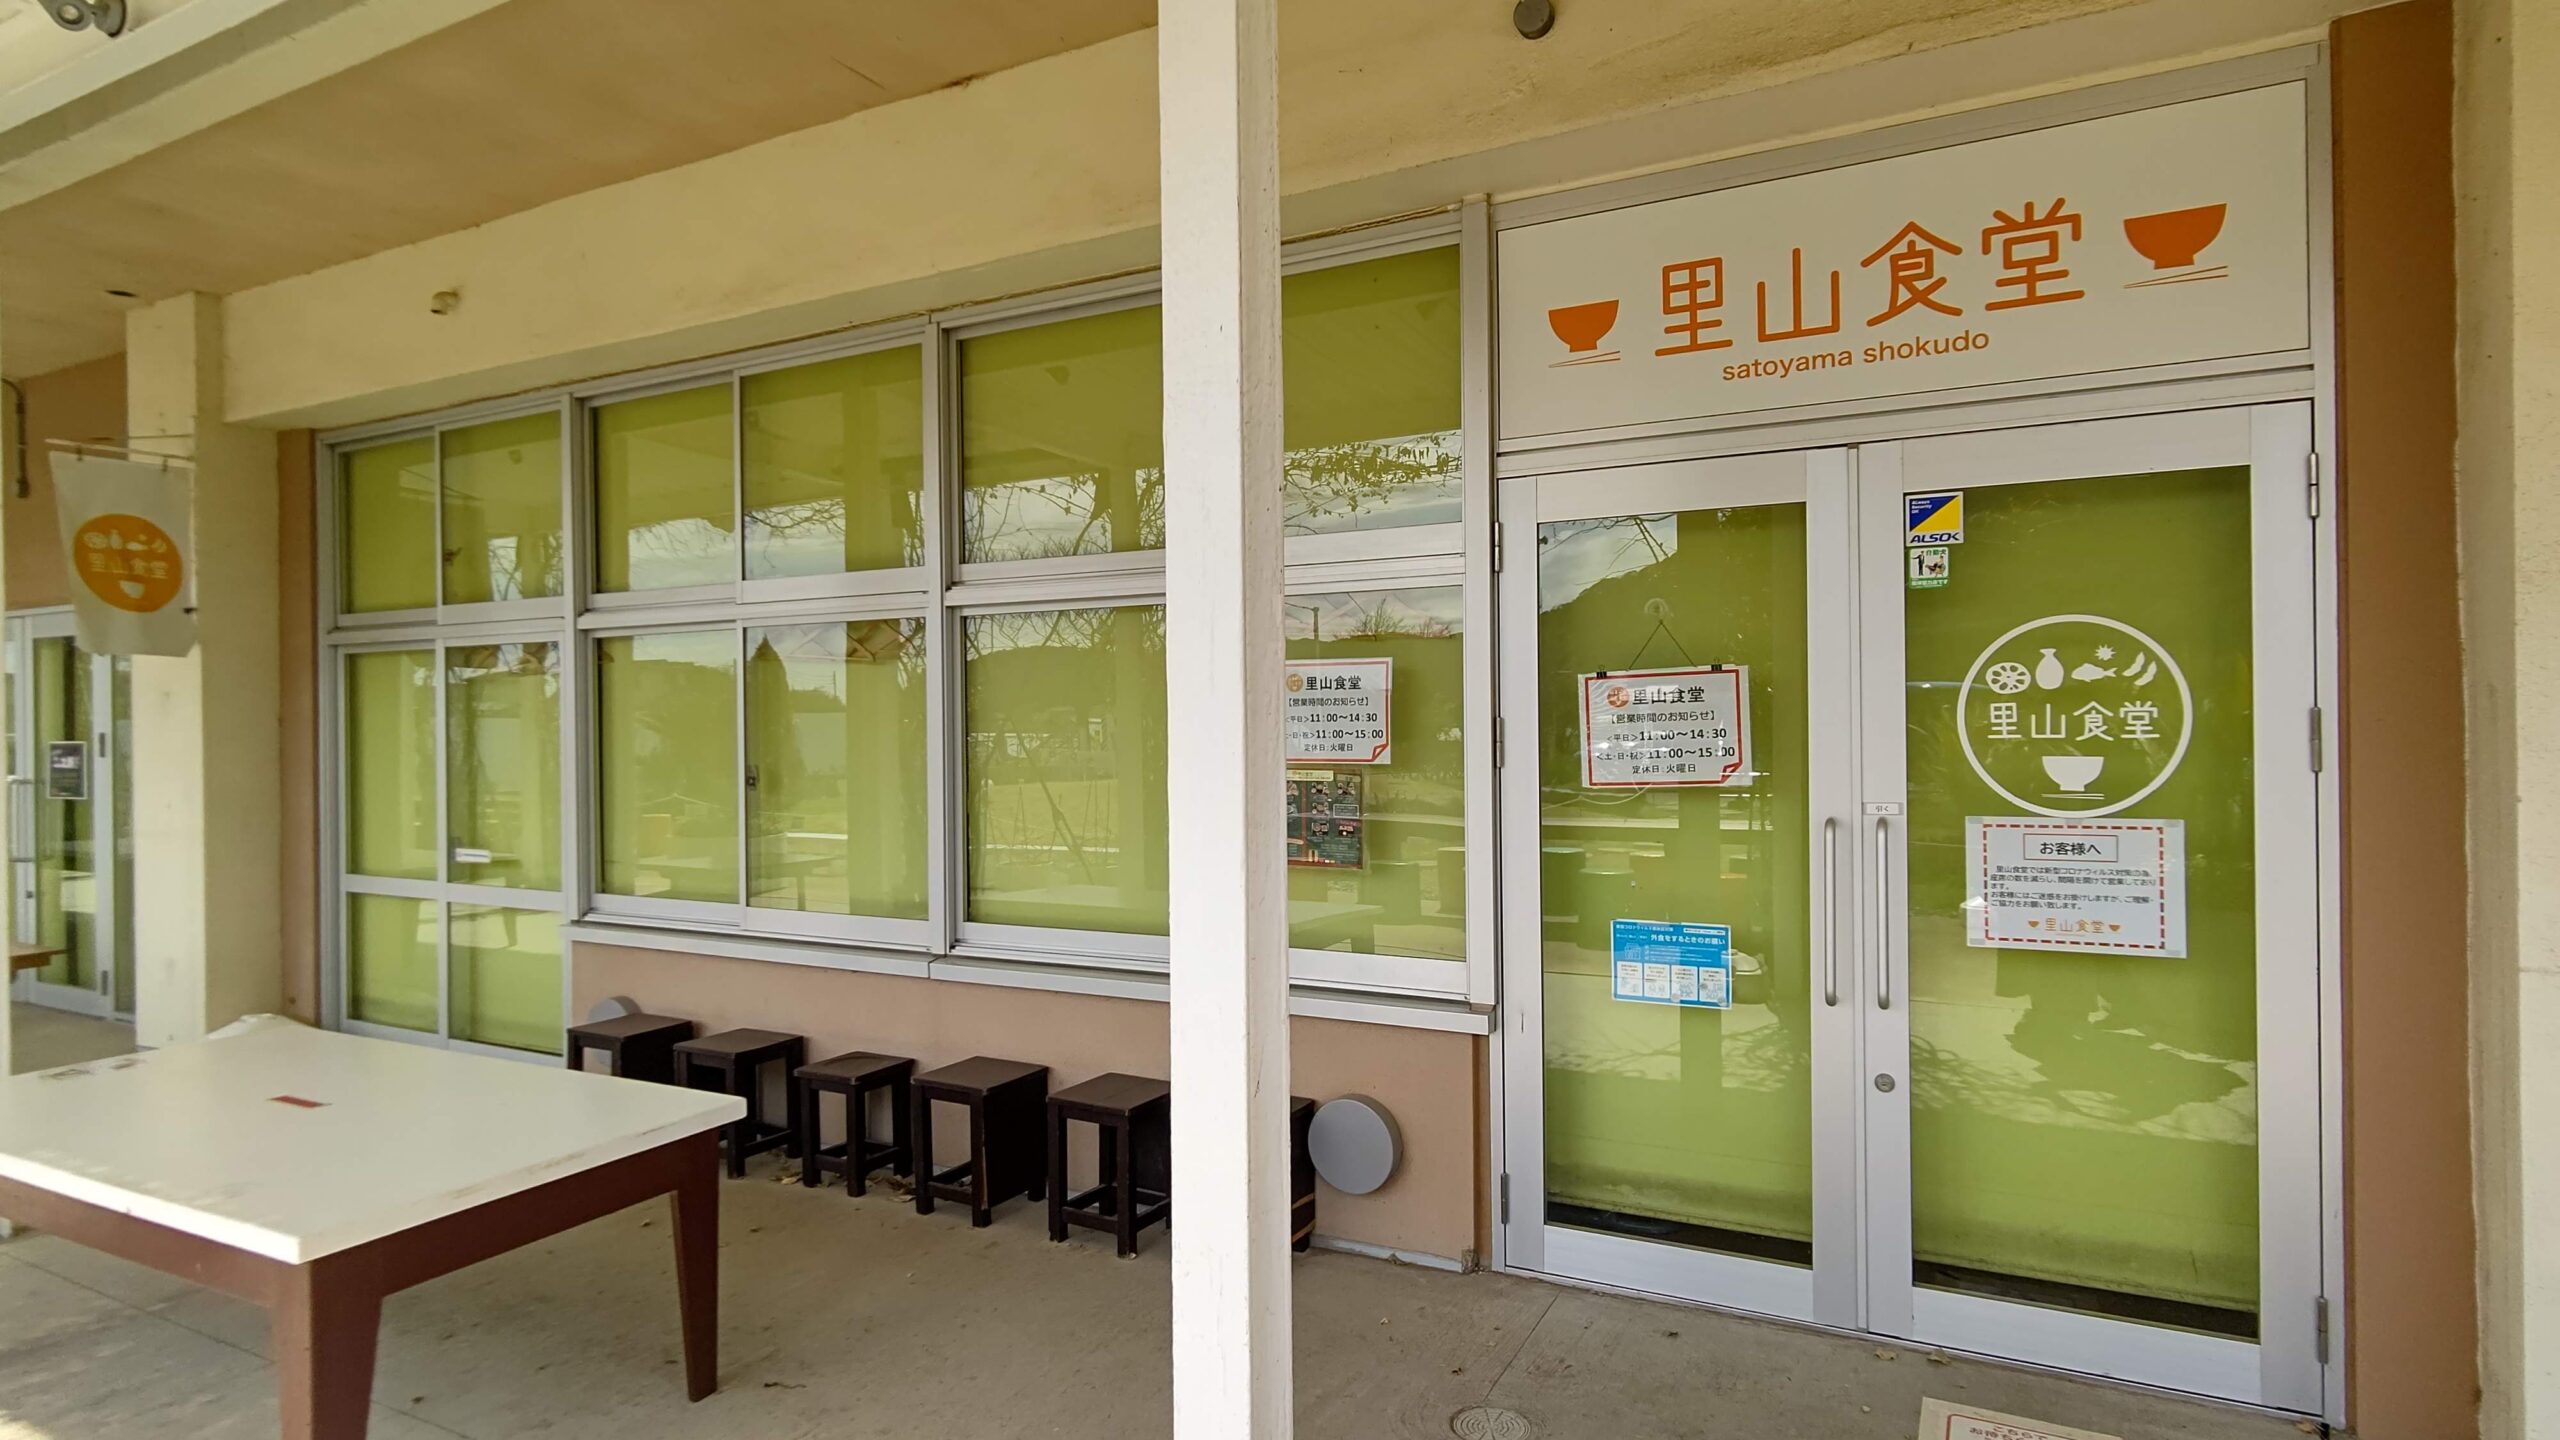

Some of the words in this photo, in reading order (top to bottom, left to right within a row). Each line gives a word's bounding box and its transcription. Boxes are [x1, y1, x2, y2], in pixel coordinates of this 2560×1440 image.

[1655, 197, 2086, 357] 里山食堂
[1721, 349, 1853, 382] satoyama
[1863, 328, 1991, 364] shokudo
[1910, 532, 1960, 544] ALSOK
[1305, 674, 1362, 691] 里山食堂
[1288, 697, 1370, 707] 【営業時間のお知らせ】
[1632, 685, 1706, 706] 里山食堂
[1611, 711, 1716, 725] 【営業時間のお知らせ】
[1987, 700, 2161, 742] 里山食堂
[2040, 841, 2102, 856] お客様へ
[2045, 918, 2105, 934] 里山食堂
